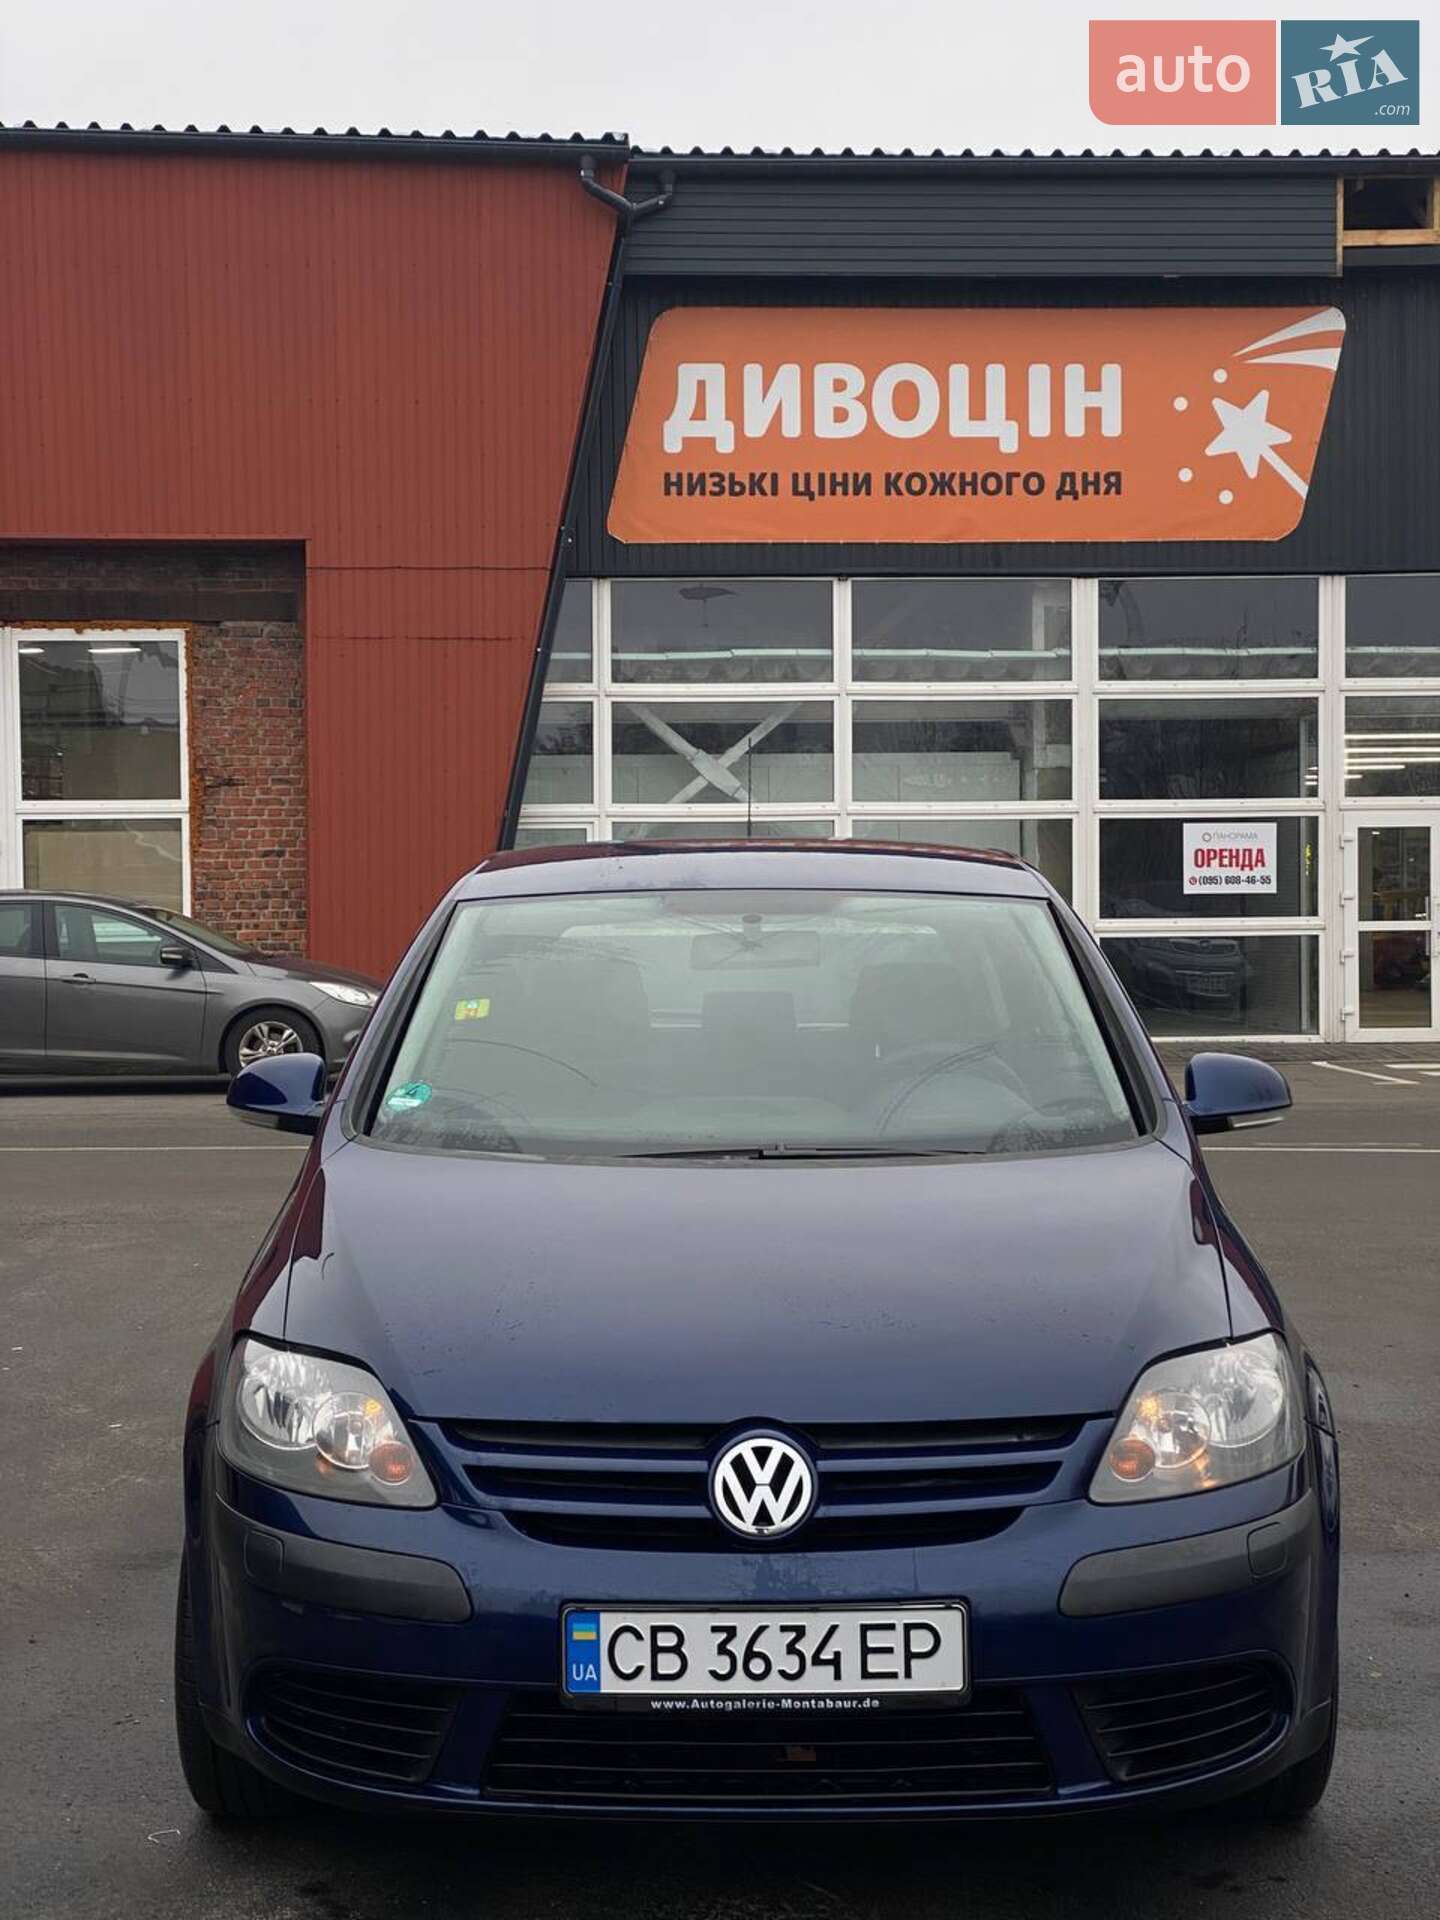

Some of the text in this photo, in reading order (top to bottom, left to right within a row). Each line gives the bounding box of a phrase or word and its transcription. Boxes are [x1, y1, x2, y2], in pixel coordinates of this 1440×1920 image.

[663, 363, 1123, 454] ДИВОЦІН
[664, 471, 1123, 501] НИЗЬКІ ЦІНИ КОЖНОГО ДНЯ
[1194, 848, 1265, 871] ОРЕНДА
[607, 1622, 941, 1681] CB 3634 EP
[572, 1664, 597, 1680] UA
[650, 1699, 880, 1711] www.Autogalerie-Montabaur.de
